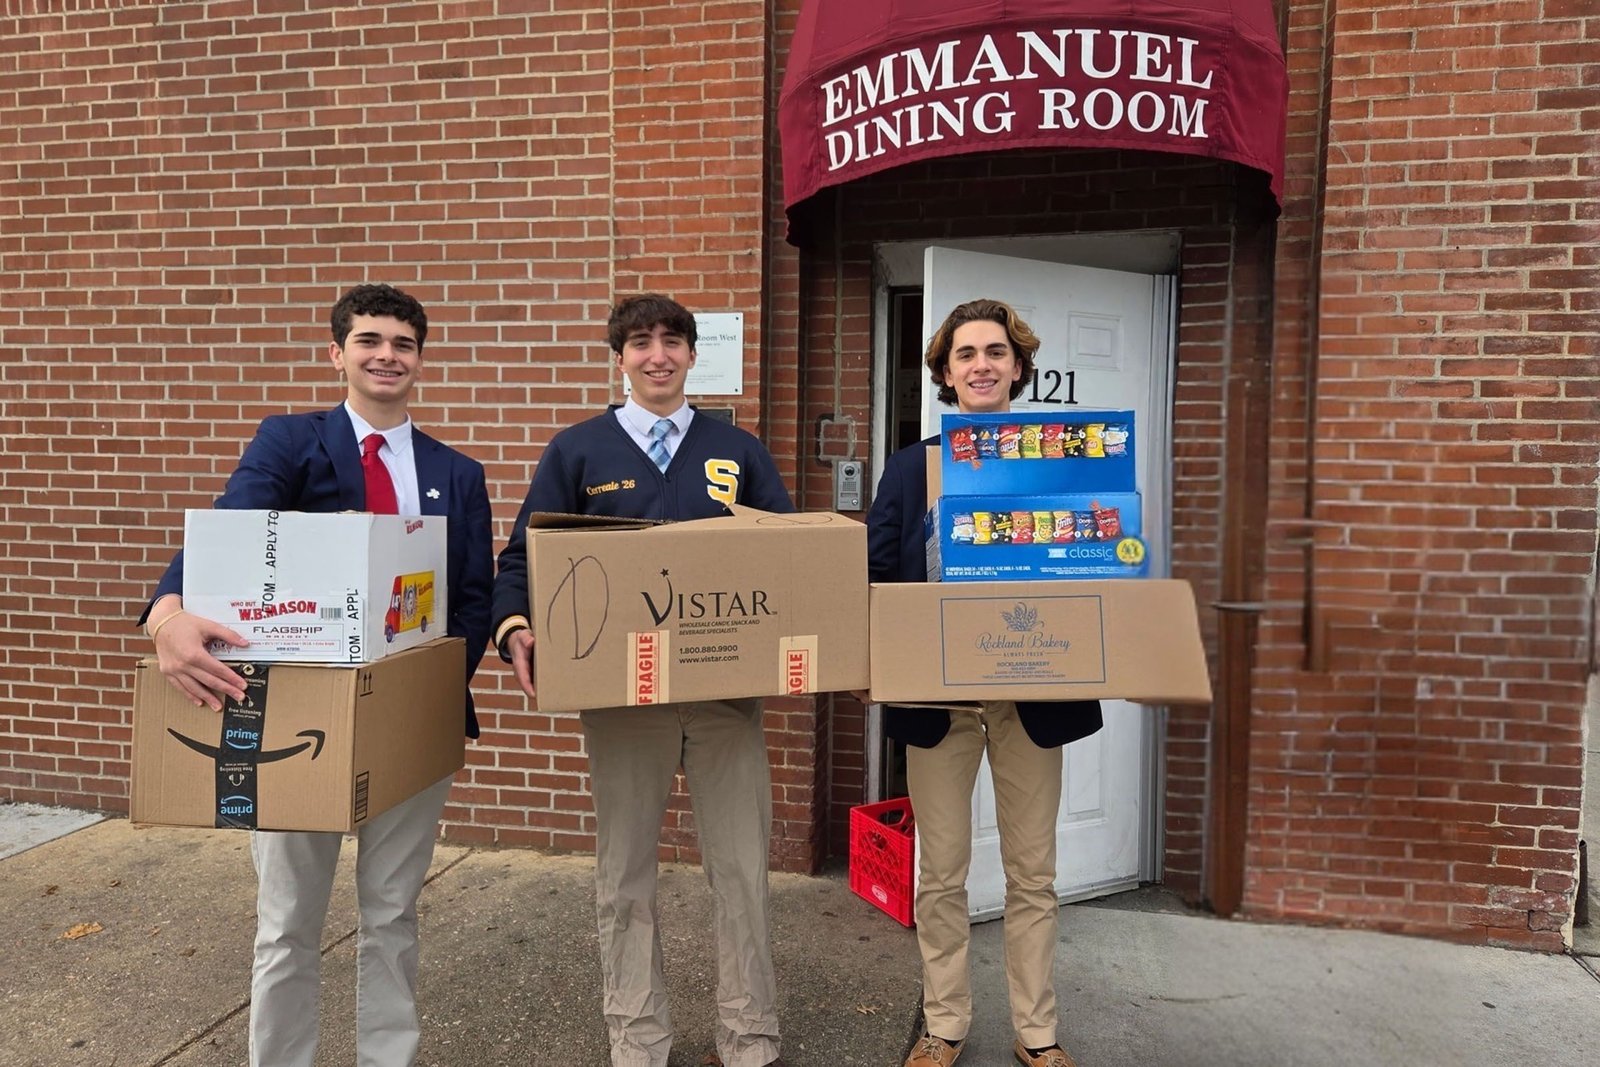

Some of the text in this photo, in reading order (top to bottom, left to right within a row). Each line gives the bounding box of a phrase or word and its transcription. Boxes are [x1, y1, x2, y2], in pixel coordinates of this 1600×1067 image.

[820, 29, 1213, 128] EMMANUEL
[825, 88, 1209, 172] DINING ROOM
[719, 334, 737, 342] West
[1028, 368, 1078, 405] 121
[704, 458, 740, 507] S
[267, 510, 280, 526] TO
[265, 529, 278, 568] APPLY
[1069, 546, 1113, 559] classic
[346, 588, 359, 620] APPL
[253, 626, 323, 634] FLAGSHIP
[679, 621, 710, 629] WHOLESALE
[679, 644, 738, 655] 1.800.880.9900
[976, 631, 1071, 652] Rockland Bakery
[679, 655, 739, 664] www.vistar.com
[638, 635, 653, 704] FRAGILE
[226, 728, 258, 741] prime
[221, 803, 253, 817] prime
